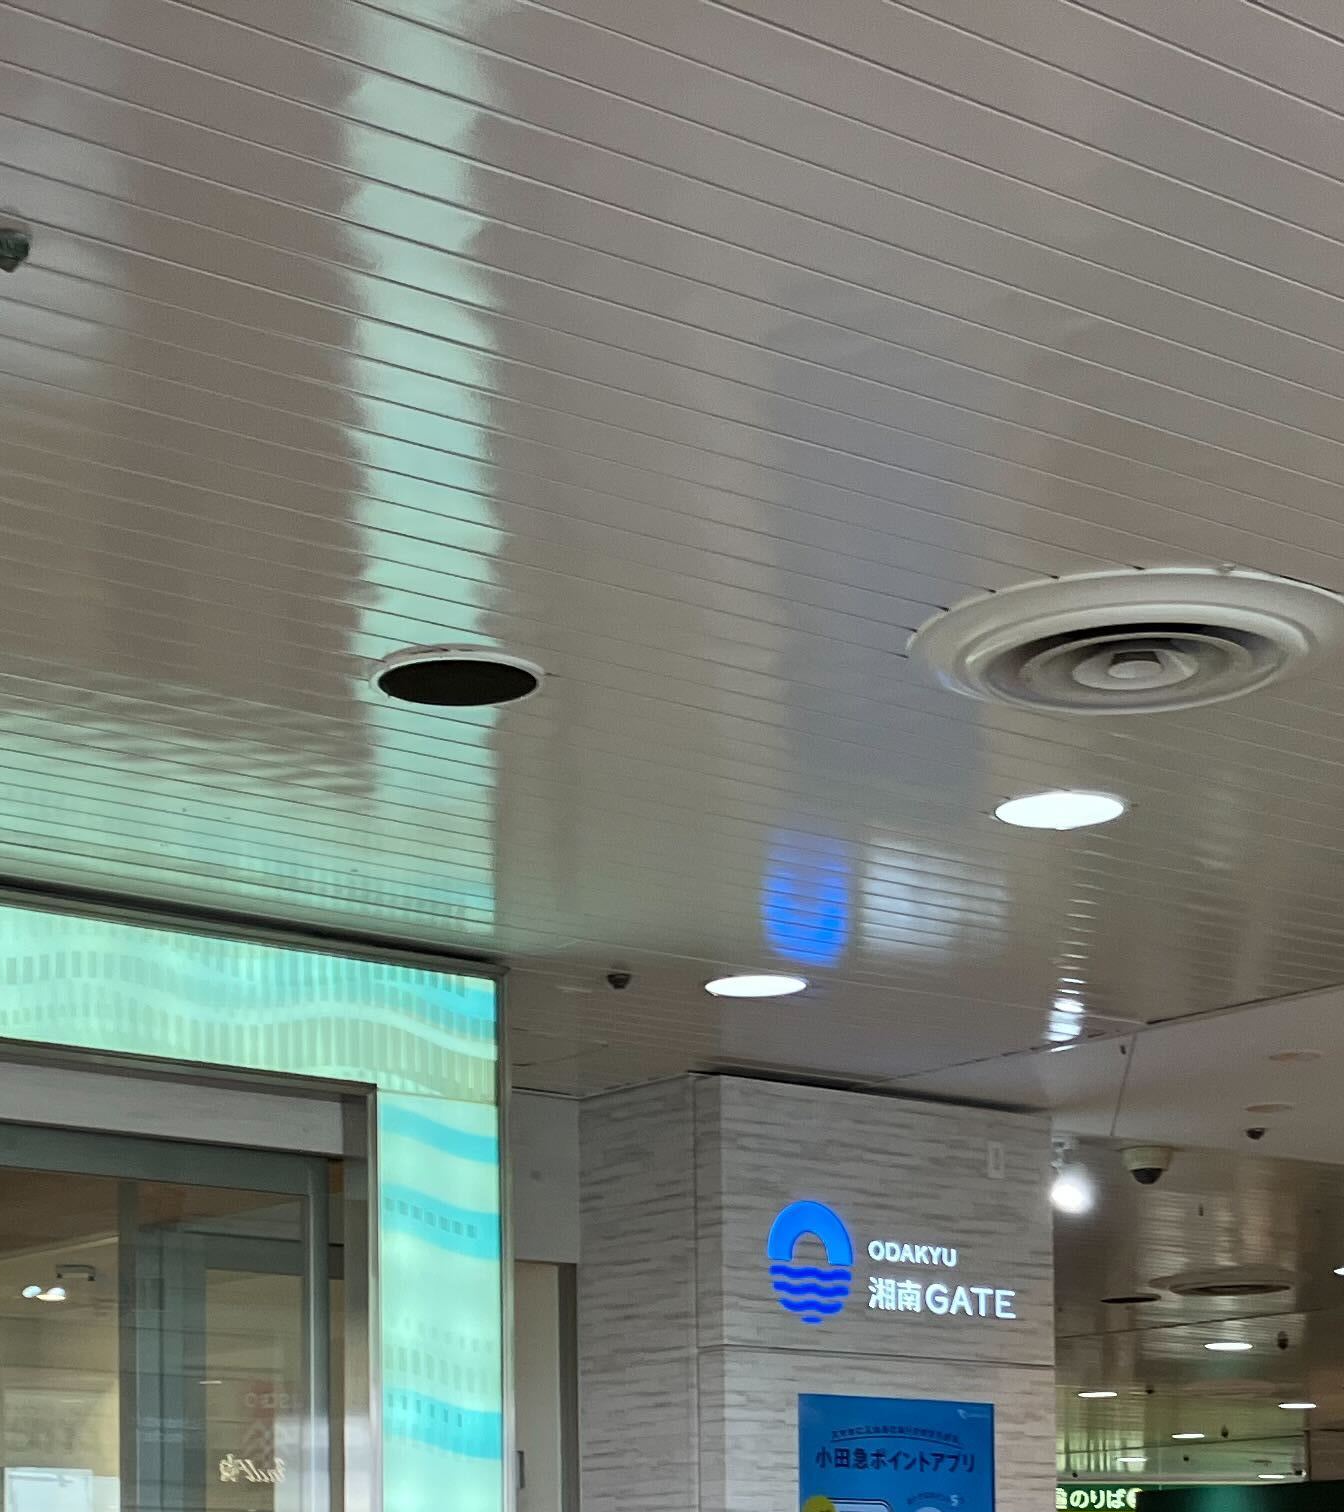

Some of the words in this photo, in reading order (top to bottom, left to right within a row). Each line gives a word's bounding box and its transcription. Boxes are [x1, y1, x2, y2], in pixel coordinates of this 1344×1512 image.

[867, 1240, 957, 1267] ODAKYU
[867, 1276, 1017, 1319] 湘南GATE
[815, 1447, 975, 1474] 小田急ポイントアプリ
